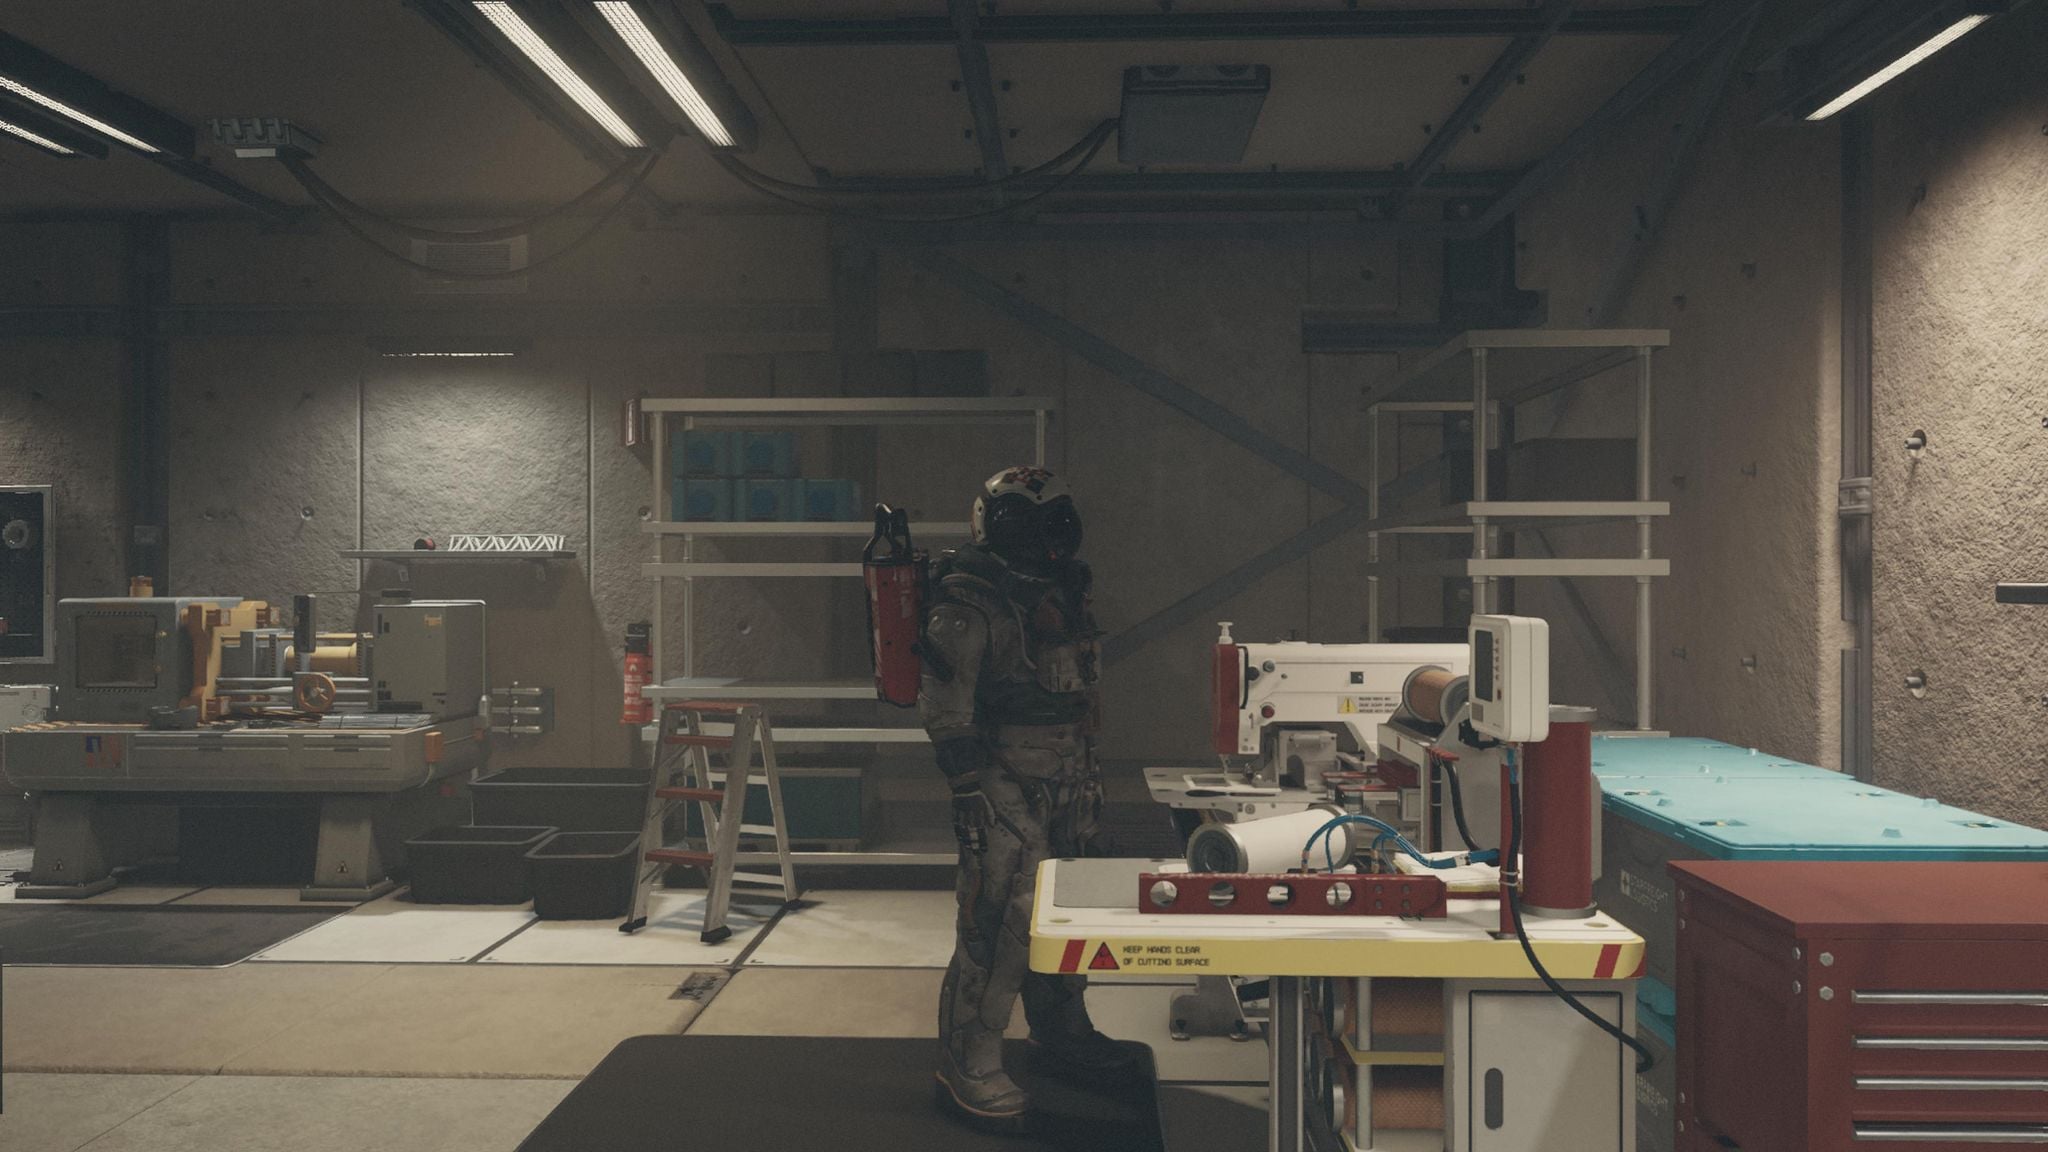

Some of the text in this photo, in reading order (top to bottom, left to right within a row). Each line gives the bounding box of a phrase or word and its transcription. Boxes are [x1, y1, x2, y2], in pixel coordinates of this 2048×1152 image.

[1123, 946, 1201, 954] KEEP HANDS CLEAR
[1123, 958, 1210, 966] OF CUTTING SURFACE
